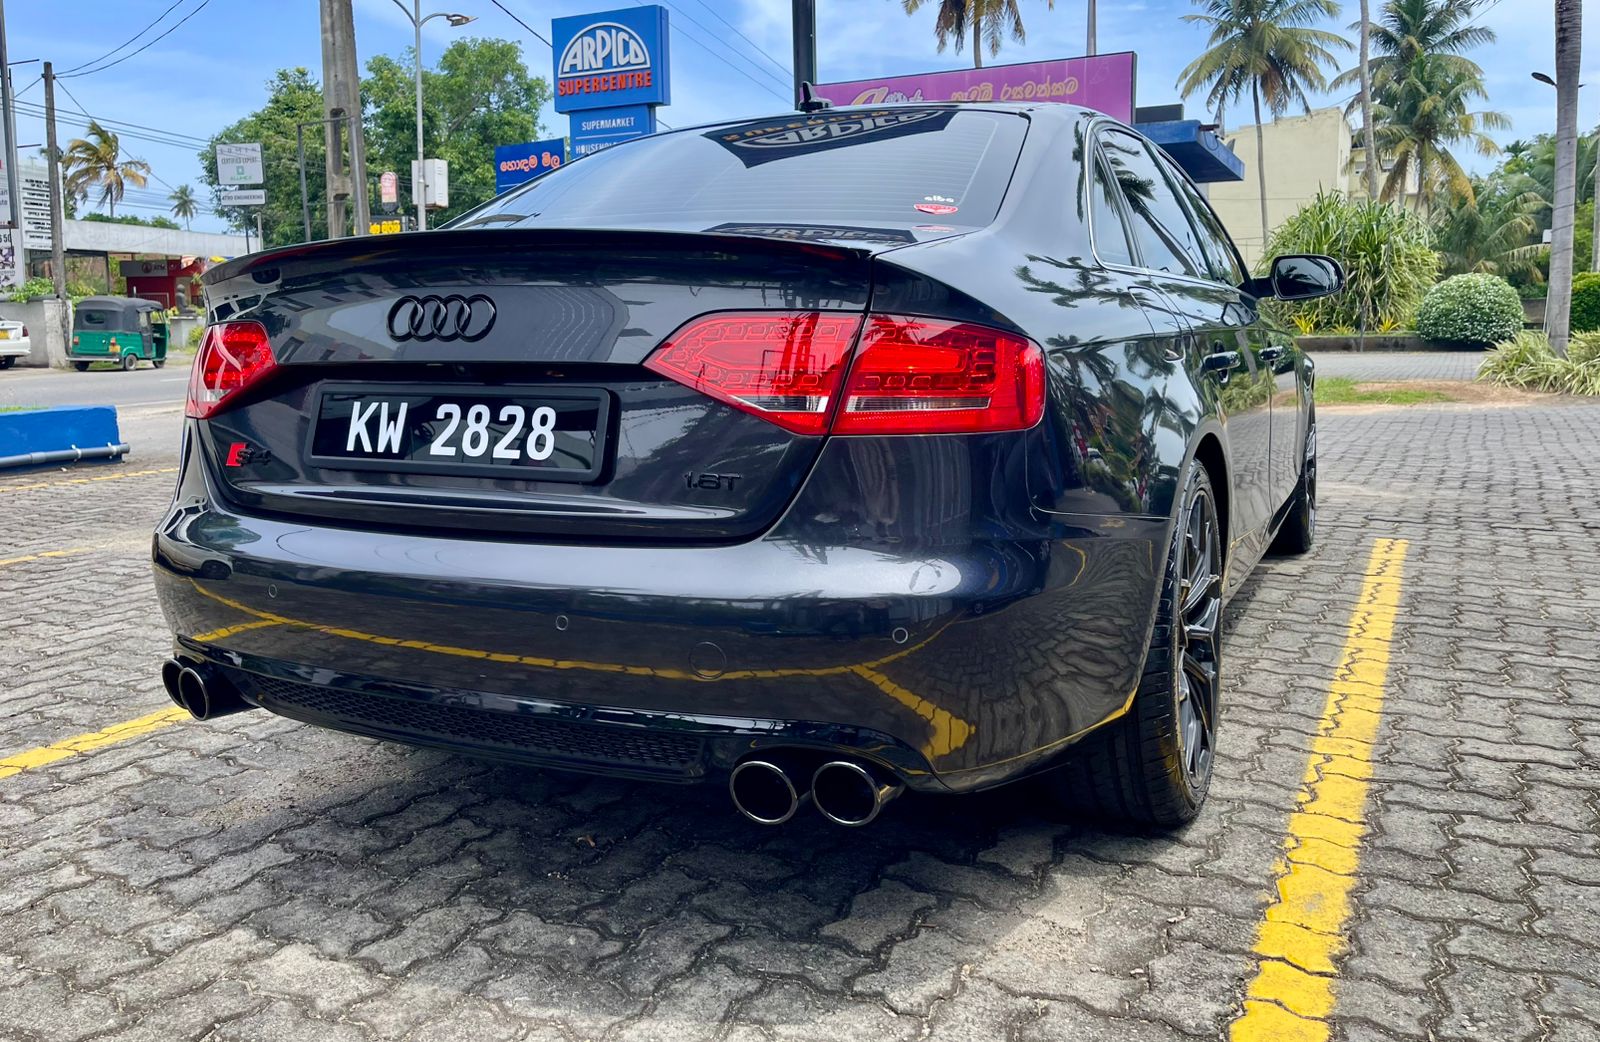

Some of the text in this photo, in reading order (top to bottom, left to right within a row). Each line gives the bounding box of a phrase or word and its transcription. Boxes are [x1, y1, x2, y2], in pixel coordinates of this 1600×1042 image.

[563, 28, 646, 73] ARPICO
[558, 71, 652, 96] SUPERCENTRE
[581, 116, 635, 131] SUPERMARKET
[575, 142, 618, 154] HOUSE
[346, 401, 556, 461] KW 2828
